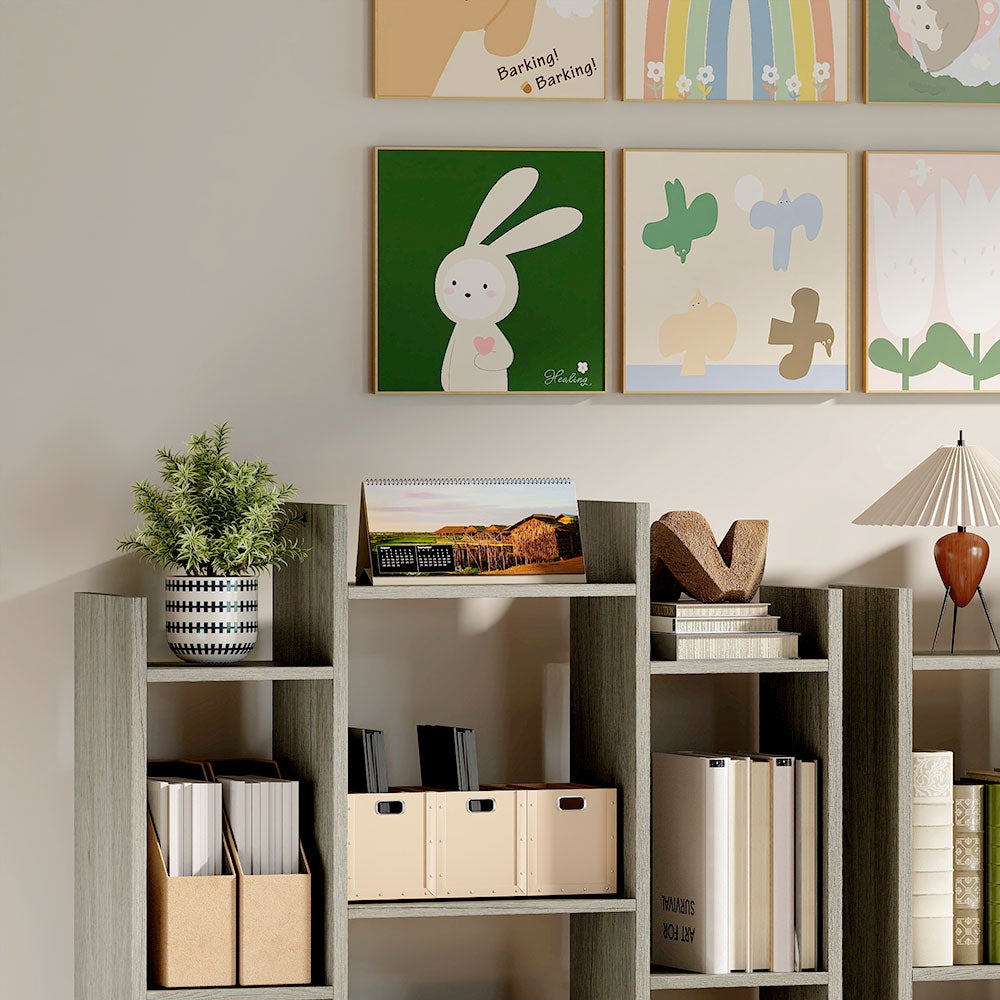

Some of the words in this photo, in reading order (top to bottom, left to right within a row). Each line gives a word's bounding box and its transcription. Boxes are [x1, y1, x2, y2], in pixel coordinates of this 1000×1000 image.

[497, 48, 559, 81] Barking!
[535, 57, 598, 91] Barking!
[661, 895, 695, 916] SURVIVAL
[663, 923, 678, 941] FOR
[681, 926, 696, 943] ART
